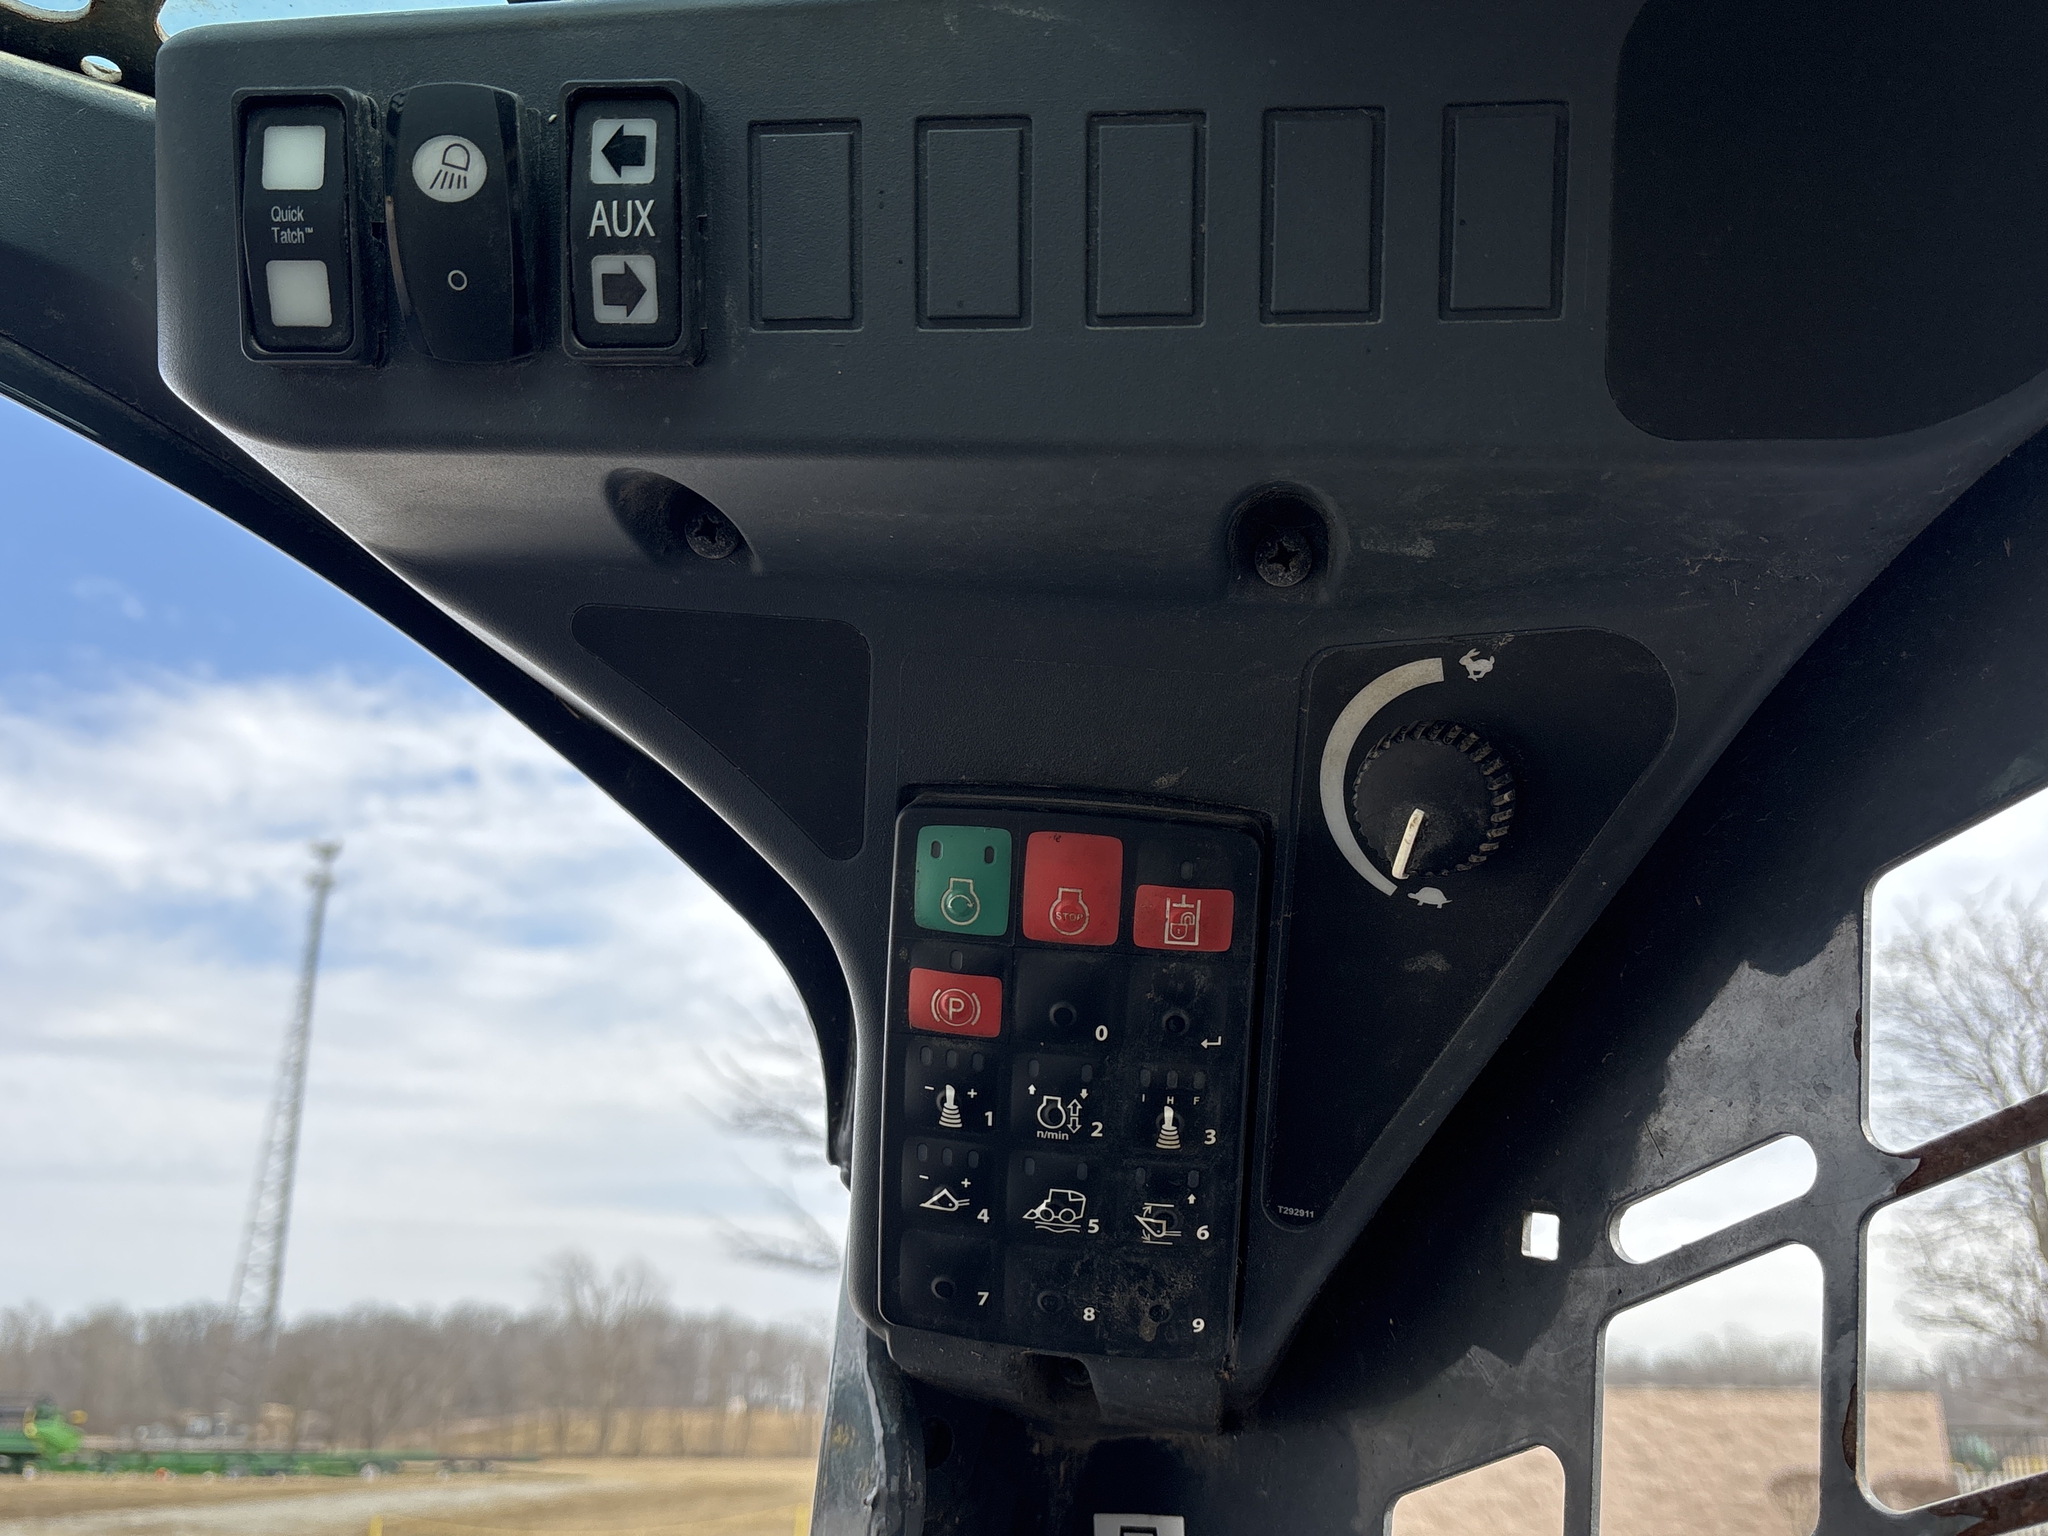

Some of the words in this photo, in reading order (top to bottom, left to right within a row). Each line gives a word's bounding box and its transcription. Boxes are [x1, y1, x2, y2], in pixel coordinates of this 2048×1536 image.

[270, 205, 305, 222] Quick
[589, 199, 656, 238] AUX
[1055, 911, 1084, 921] STOP
[948, 997, 965, 1021] P
[1166, 1095, 1175, 1105] H
[1193, 1096, 1201, 1106] F
[984, 1110, 993, 1127] 1
[1036, 1130, 1069, 1141] n/min
[1090, 1121, 1103, 1138] 2
[1203, 1128, 1217, 1145] 3
[976, 1208, 990, 1224] 4
[1087, 1218, 1100, 1234] 5
[1196, 1224, 1210, 1241] 6
[977, 1291, 990, 1306] 7
[1082, 1306, 1096, 1322] 8
[1192, 1317, 1205, 1333] 9
